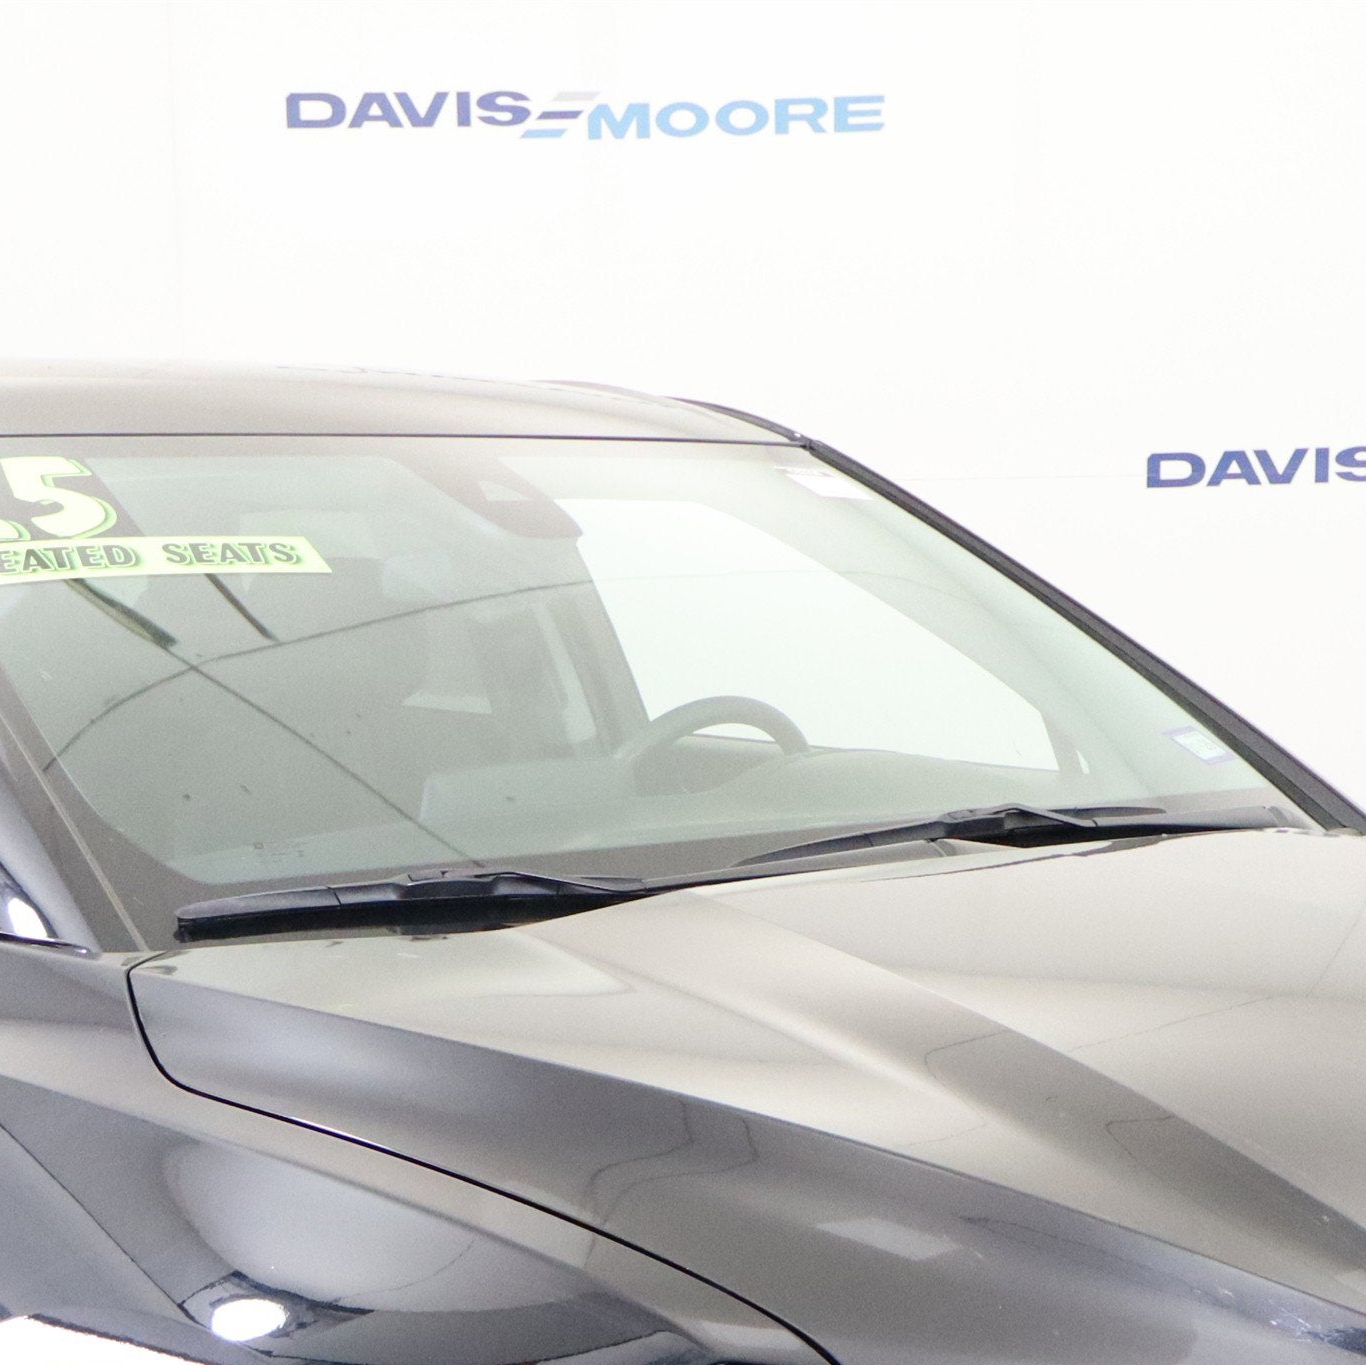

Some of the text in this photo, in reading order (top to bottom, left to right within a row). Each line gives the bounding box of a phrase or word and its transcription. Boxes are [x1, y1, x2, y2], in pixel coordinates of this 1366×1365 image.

[285, 90, 885, 140] DAVIS MOORE
[161, 541, 303, 567] SEATS
